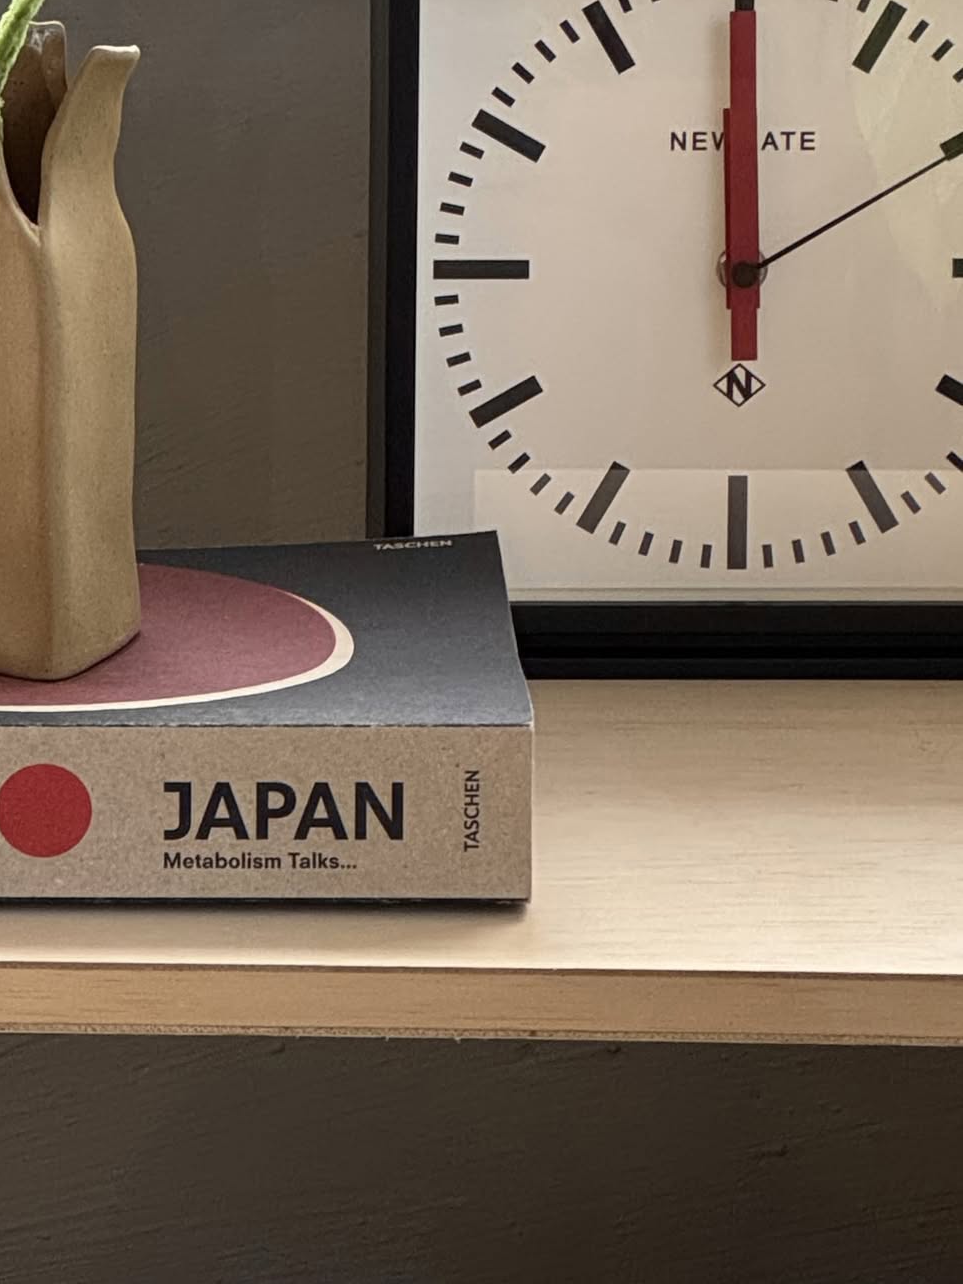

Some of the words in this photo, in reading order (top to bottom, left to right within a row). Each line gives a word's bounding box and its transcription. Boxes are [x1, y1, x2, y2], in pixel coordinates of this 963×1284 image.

[669, 131, 816, 152] NEWATE
[374, 539, 452, 550] TASCHEN
[163, 781, 404, 841] JAPAN
[463, 770, 480, 853] TASCHEN
[163, 851, 282, 870] Metabolism
[287, 851, 357, 870] Talks...
